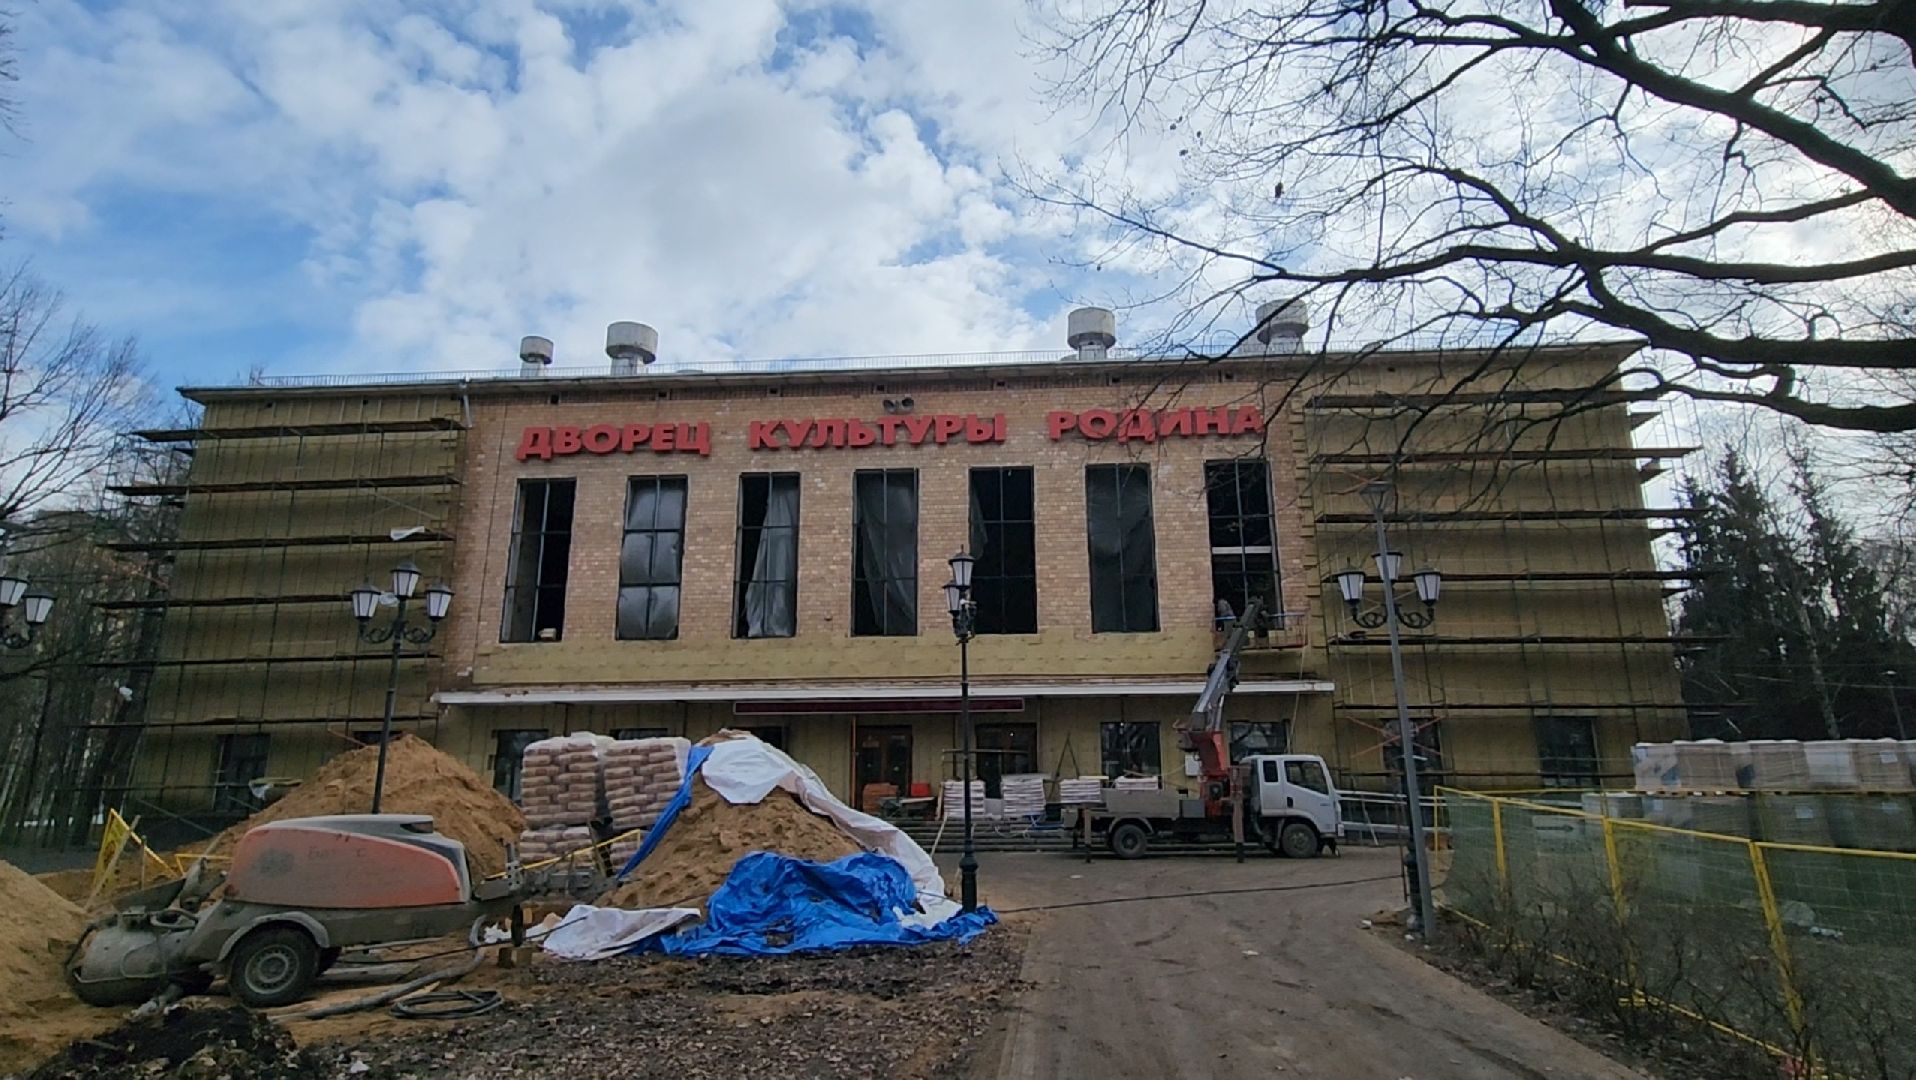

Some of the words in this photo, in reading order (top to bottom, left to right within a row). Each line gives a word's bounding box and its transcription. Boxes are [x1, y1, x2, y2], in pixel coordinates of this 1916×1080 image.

[516, 420, 711, 461] ДВОРЕЦ
[749, 413, 1007, 449] КУЛЬТУРЫ
[1047, 404, 1265, 444] РОДИНА
